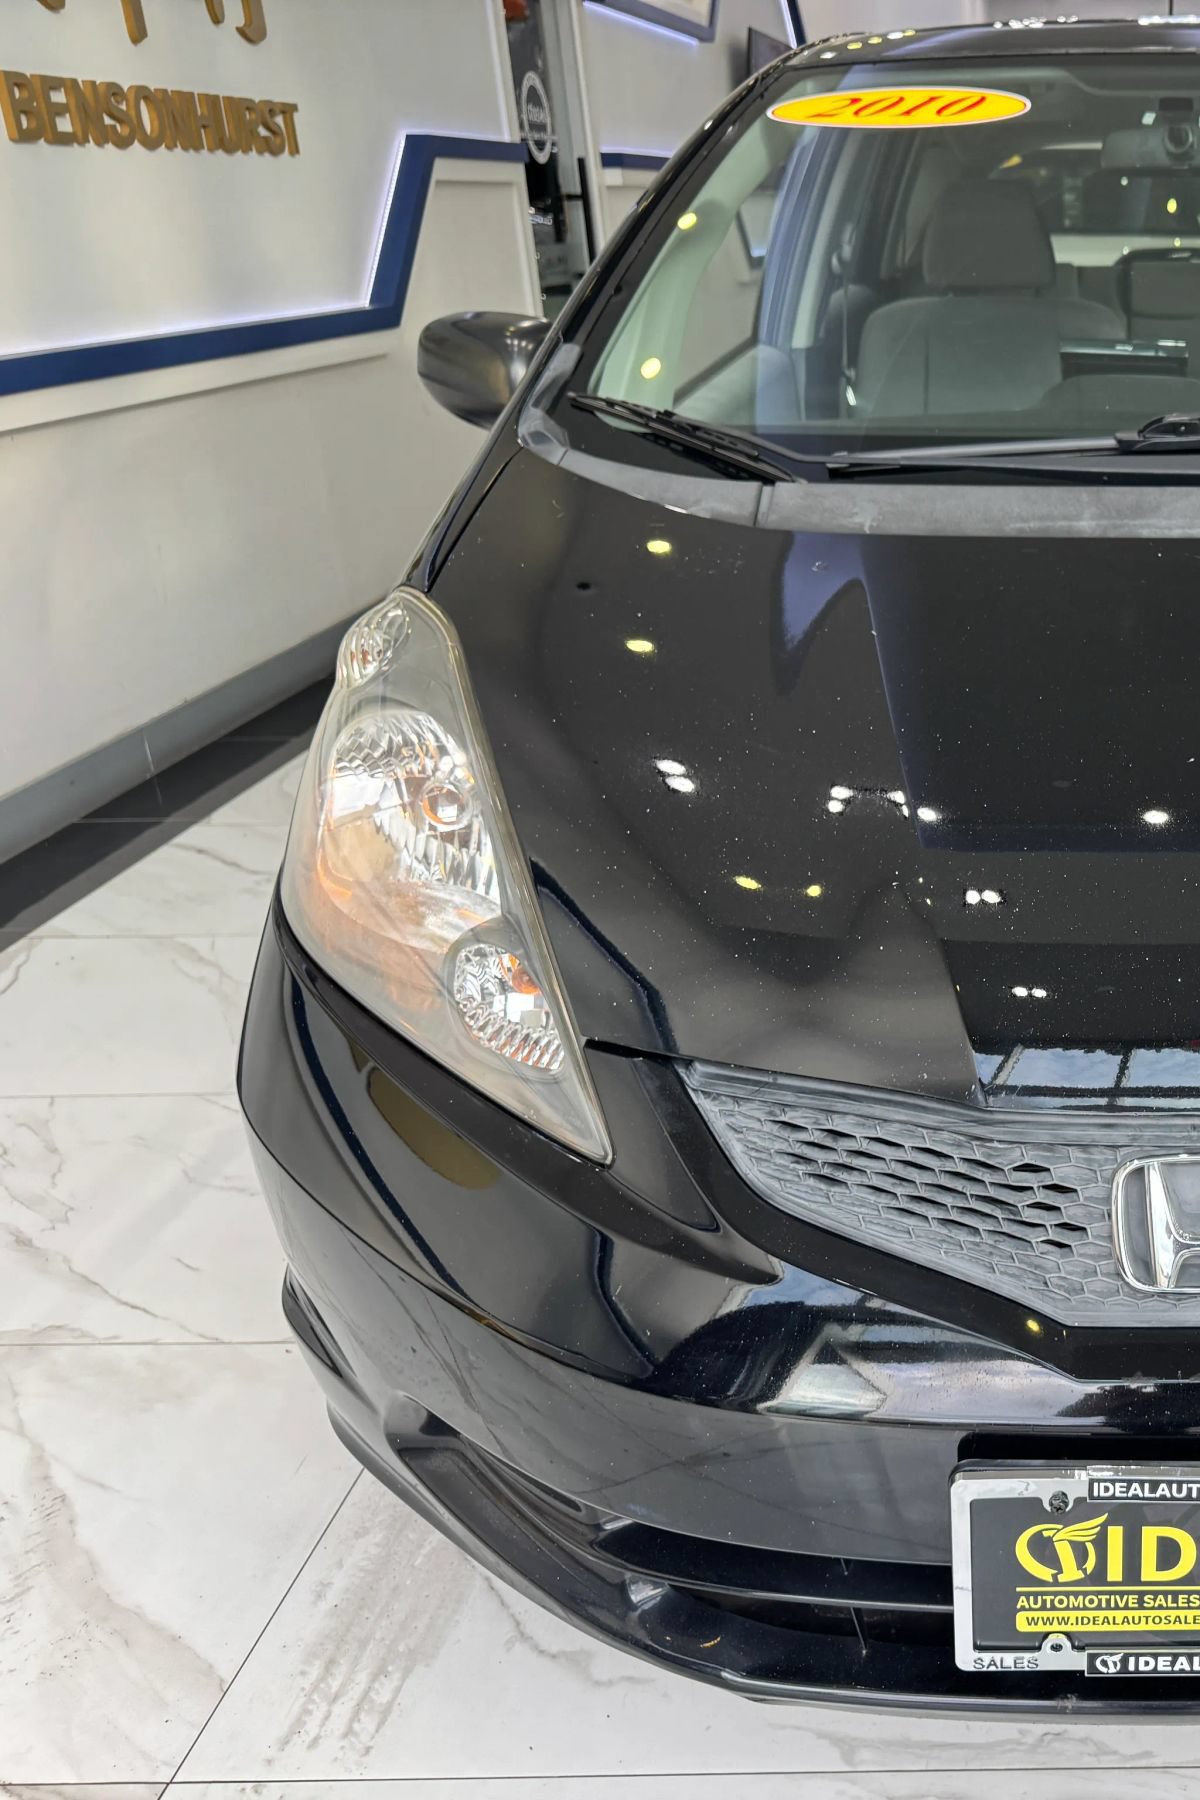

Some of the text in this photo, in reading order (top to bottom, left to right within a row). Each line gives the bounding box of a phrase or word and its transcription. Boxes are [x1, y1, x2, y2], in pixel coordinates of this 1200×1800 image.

[0, 70, 300, 157] BENSONHURST
[806, 95, 988, 119] 2010
[1016, 1594, 1139, 1610] AUTOMOTIVE
[1142, 1594, 1200, 1609] SALES
[972, 1656, 1039, 1670] SALES
